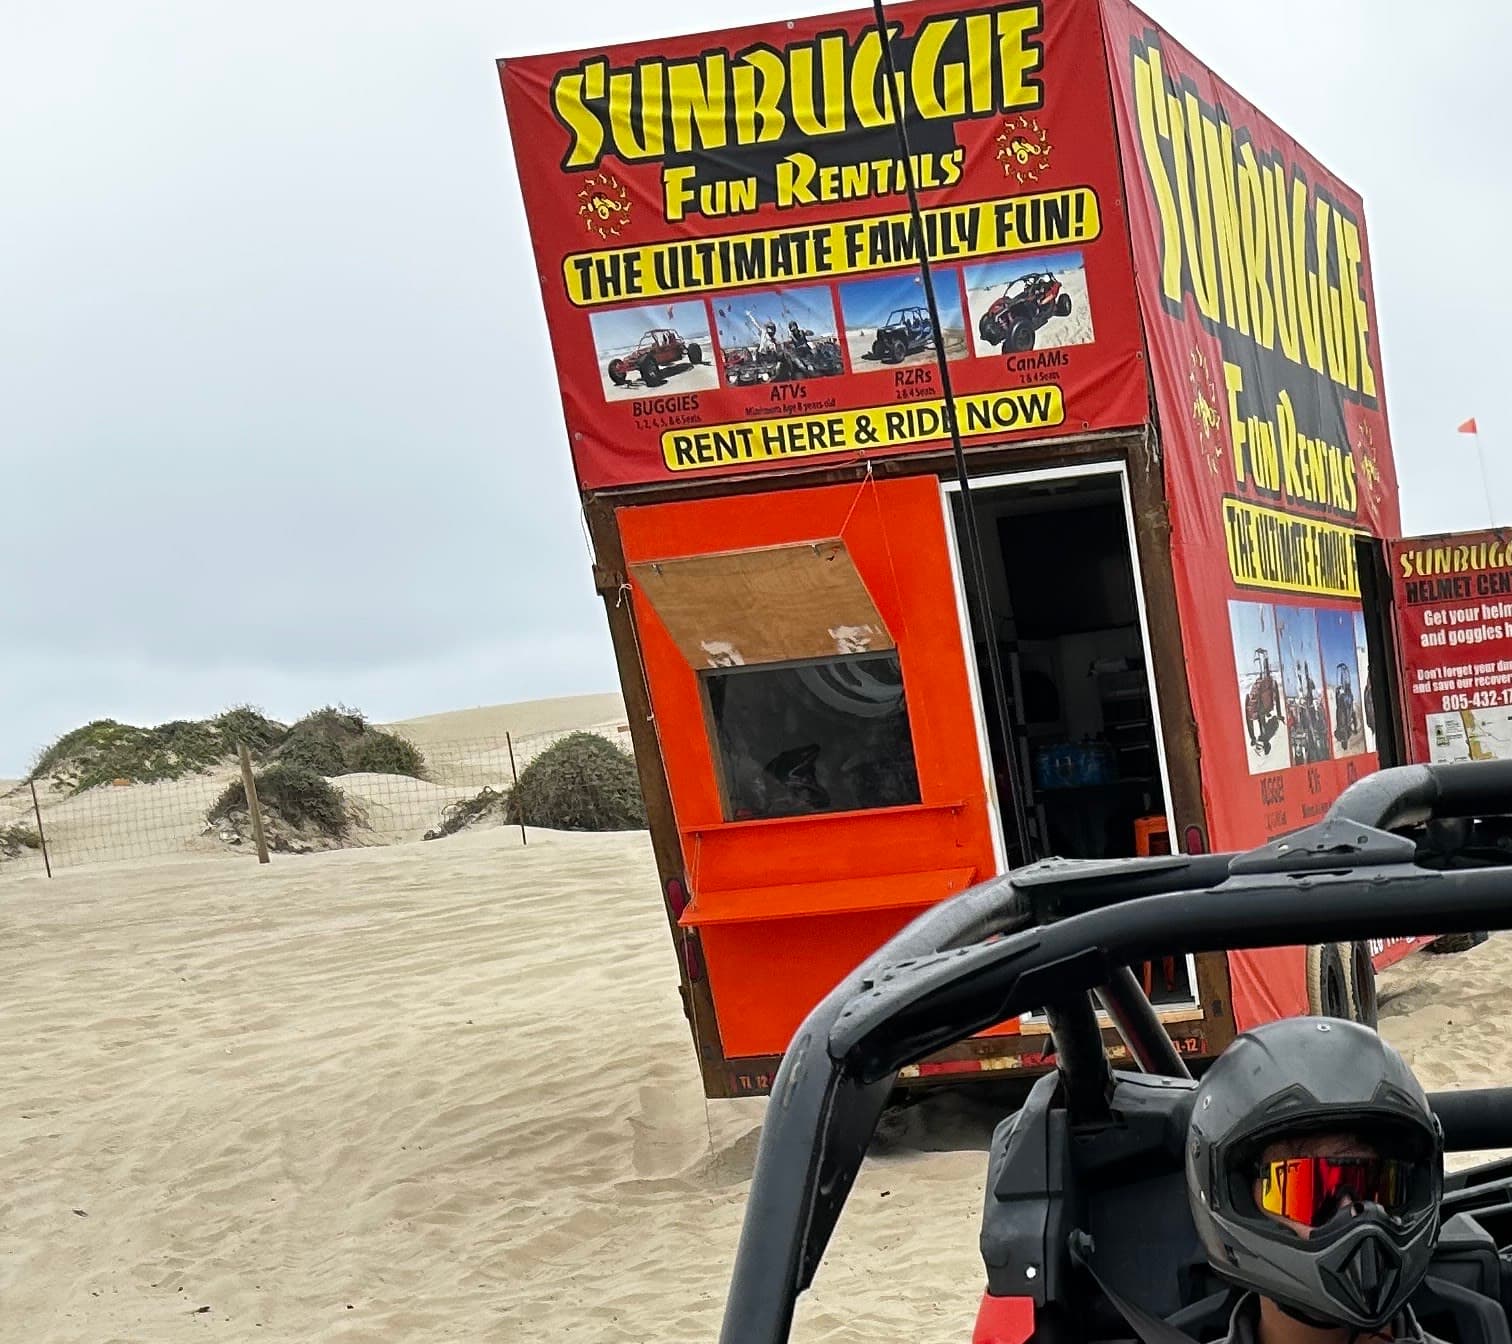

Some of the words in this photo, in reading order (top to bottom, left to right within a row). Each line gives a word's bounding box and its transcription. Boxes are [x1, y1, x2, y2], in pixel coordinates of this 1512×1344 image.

[553, 5, 1041, 169] SUNBUGGIE
[662, 165, 758, 221] FUN
[1133, 45, 1377, 399] SUNBUGGIE
[573, 251, 643, 301] THE
[653, 228, 832, 291] ULTIMATE
[844, 206, 982, 268] FAMILY
[993, 191, 1086, 249] FUN!
[1006, 350, 1069, 373] CanAMs
[895, 368, 932, 387] RZRs
[770, 383, 807, 401] ATVs
[632, 395, 700, 417] BUGGIES
[672, 427, 754, 466] RENT
[761, 417, 846, 456] HERE
[853, 414, 881, 445] &
[966, 391, 1053, 431] NOW
[1226, 505, 1257, 579] THE
[1255, 512, 1312, 586] ULTIMATE
[1310, 526, 1349, 591] FAMILY
[1404, 576, 1473, 604] HELMET
[1423, 609, 1448, 627] Get
[1448, 606, 1480, 626] your
[1420, 628, 1446, 648] and
[1448, 624, 1503, 647] goggles
[1416, 667, 1443, 681] Don't
[1443, 665, 1473, 679] forget
[1474, 662, 1496, 676] your
[1412, 681, 1431, 694] and
[1432, 679, 1455, 692] save
[1456, 677, 1473, 689] our
